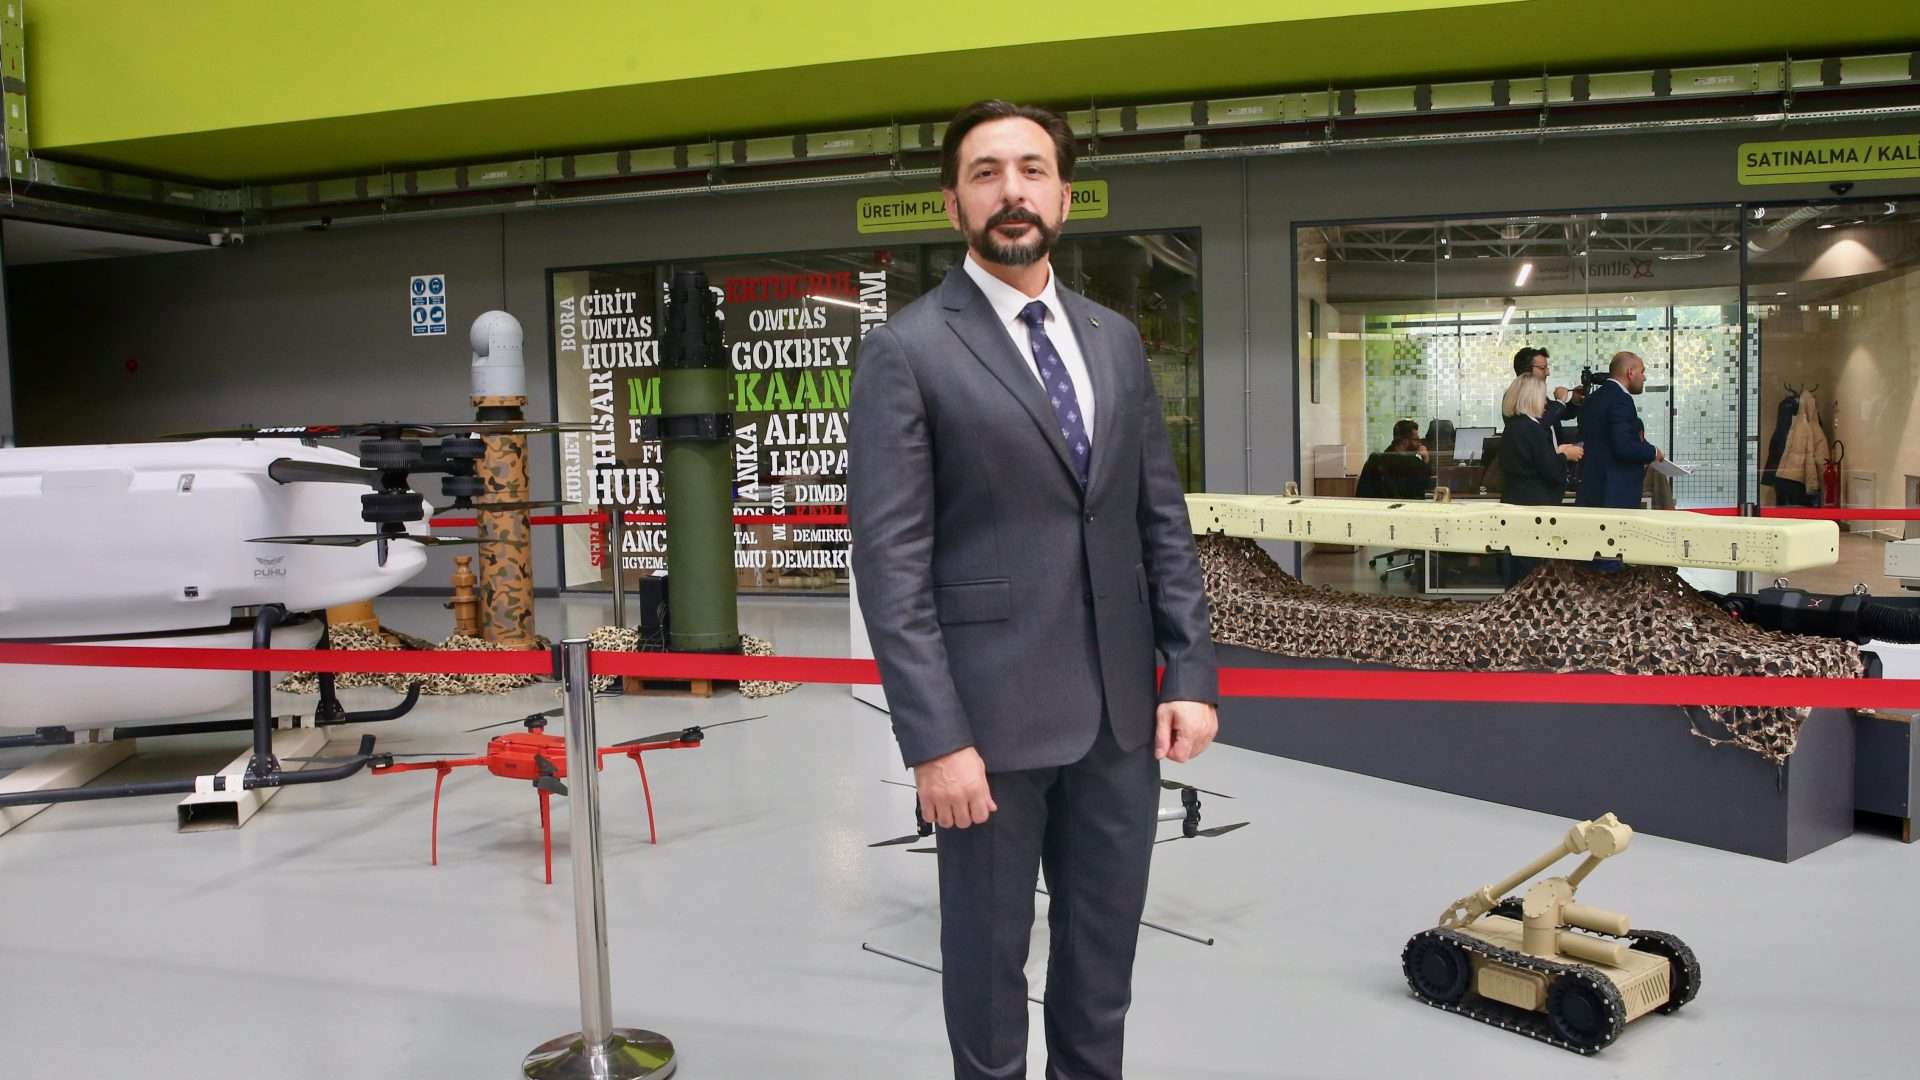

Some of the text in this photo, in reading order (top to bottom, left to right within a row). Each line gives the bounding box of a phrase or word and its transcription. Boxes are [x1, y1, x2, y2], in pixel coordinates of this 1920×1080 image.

[1746, 149, 1859, 168] SATINALMA
[862, 201, 917, 219] ÜRETİM
[560, 296, 577, 352] BORA
[581, 316, 652, 340] UMTAS
[749, 306, 827, 332] OMTAS
[731, 336, 852, 370] GOKBEY
[764, 412, 848, 445] ALTA
[736, 422, 759, 502] ANKA
[608, 530, 668, 552] ANC
